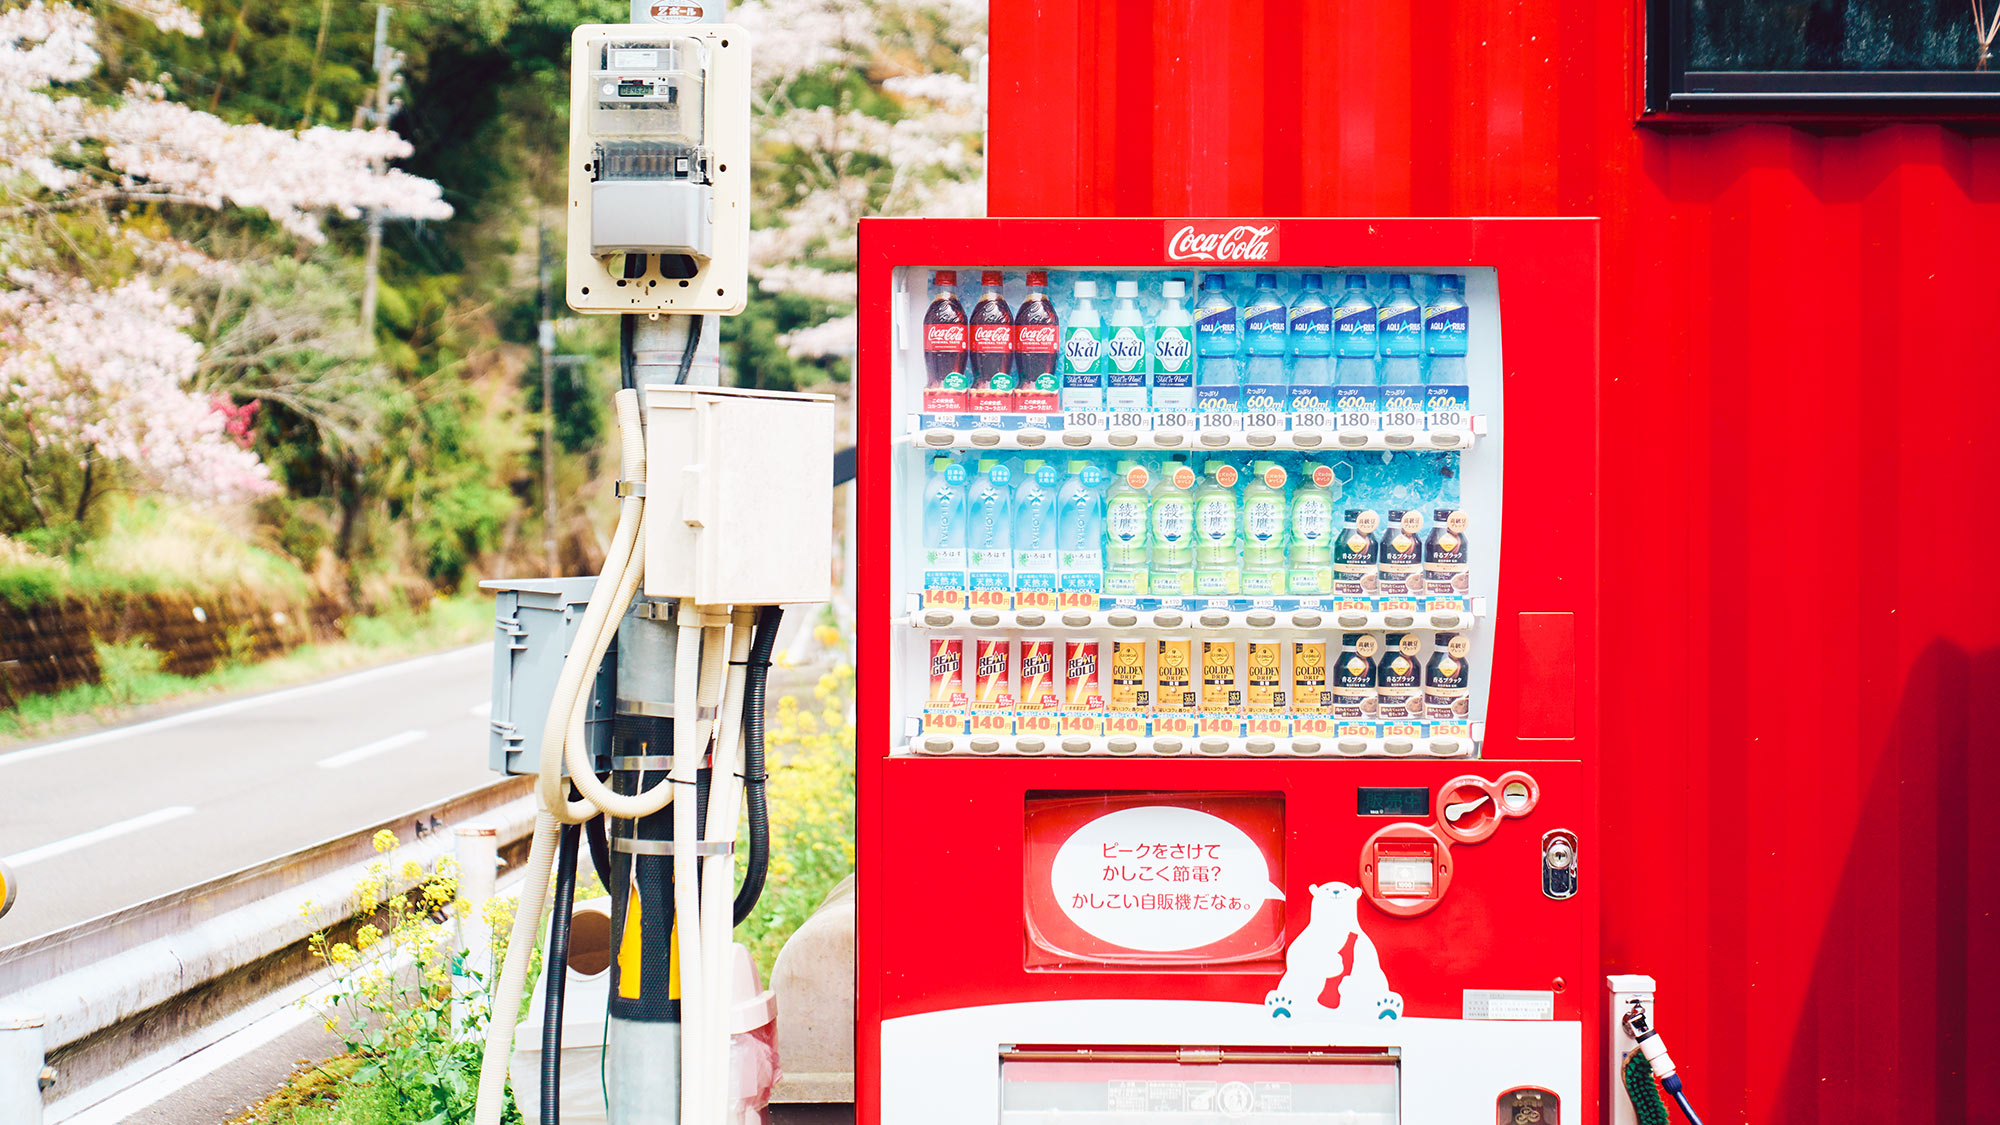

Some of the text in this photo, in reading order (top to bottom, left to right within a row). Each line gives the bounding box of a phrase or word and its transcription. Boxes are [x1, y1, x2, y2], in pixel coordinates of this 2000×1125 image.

[1168, 226, 1275, 260] Coca-Cola
[928, 326, 963, 340] Coca-Cola
[1201, 320, 1234, 335] AQUARIUS
[1250, 319, 1285, 333] AQUARIUS
[1295, 320, 1329, 334] AQUARIUS
[1340, 320, 1375, 335] AQUARIUS
[1387, 320, 1420, 334] AQUARIUS
[1431, 319, 1465, 333] AQUARIUS
[975, 326, 1010, 341] Coca-Cola
[1020, 327, 1055, 341] Coca-Cola
[1199, 397, 1238, 408] 600ml
[1247, 395, 1284, 408] 600ml
[1292, 396, 1329, 409] 600ml
[1337, 396, 1376, 408] 600ml
[1385, 397, 1423, 408] 600ml
[1427, 396, 1467, 407] 600ml
[932, 577, 958, 585] 天然水
[976, 578, 1003, 586] 天然水
[1023, 579, 1049, 587] 天然水
[1068, 579, 1095, 587] 天然水
[933, 650, 960, 665] REAL
[979, 652, 1007, 667] REAL
[1023, 652, 1052, 667] REAL
[1068, 653, 1096, 669] REAL
[933, 661, 959, 675] GOLD
[979, 662, 1005, 677] GOLD
[1023, 663, 1050, 678] GOLD
[1068, 664, 1095, 679] GOLD
[1113, 665, 1143, 676] GOLDEN
[1159, 667, 1189, 677] GOLDEN
[1204, 665, 1234, 675] GOLDEN
[1249, 666, 1280, 677] GOLDEN
[1296, 666, 1326, 676] GOLDEN
[924, 714, 964, 728] 140円
[972, 716, 1011, 730] 140円
[1018, 717, 1057, 730] 140円
[1062, 717, 1101, 731] 140円
[1105, 718, 1145, 732] 140円
[1154, 719, 1193, 733] 140円
[1200, 719, 1240, 733] 140円
[1248, 720, 1289, 733] 140円
[1294, 719, 1334, 733] 140円
[1366, 793, 1421, 809] 販売中
[1103, 843, 1221, 859] ピークをさけて
[1103, 865, 1221, 882] かしこく節電?
[1072, 893, 1251, 911] かしこい自販機だなぁ。
